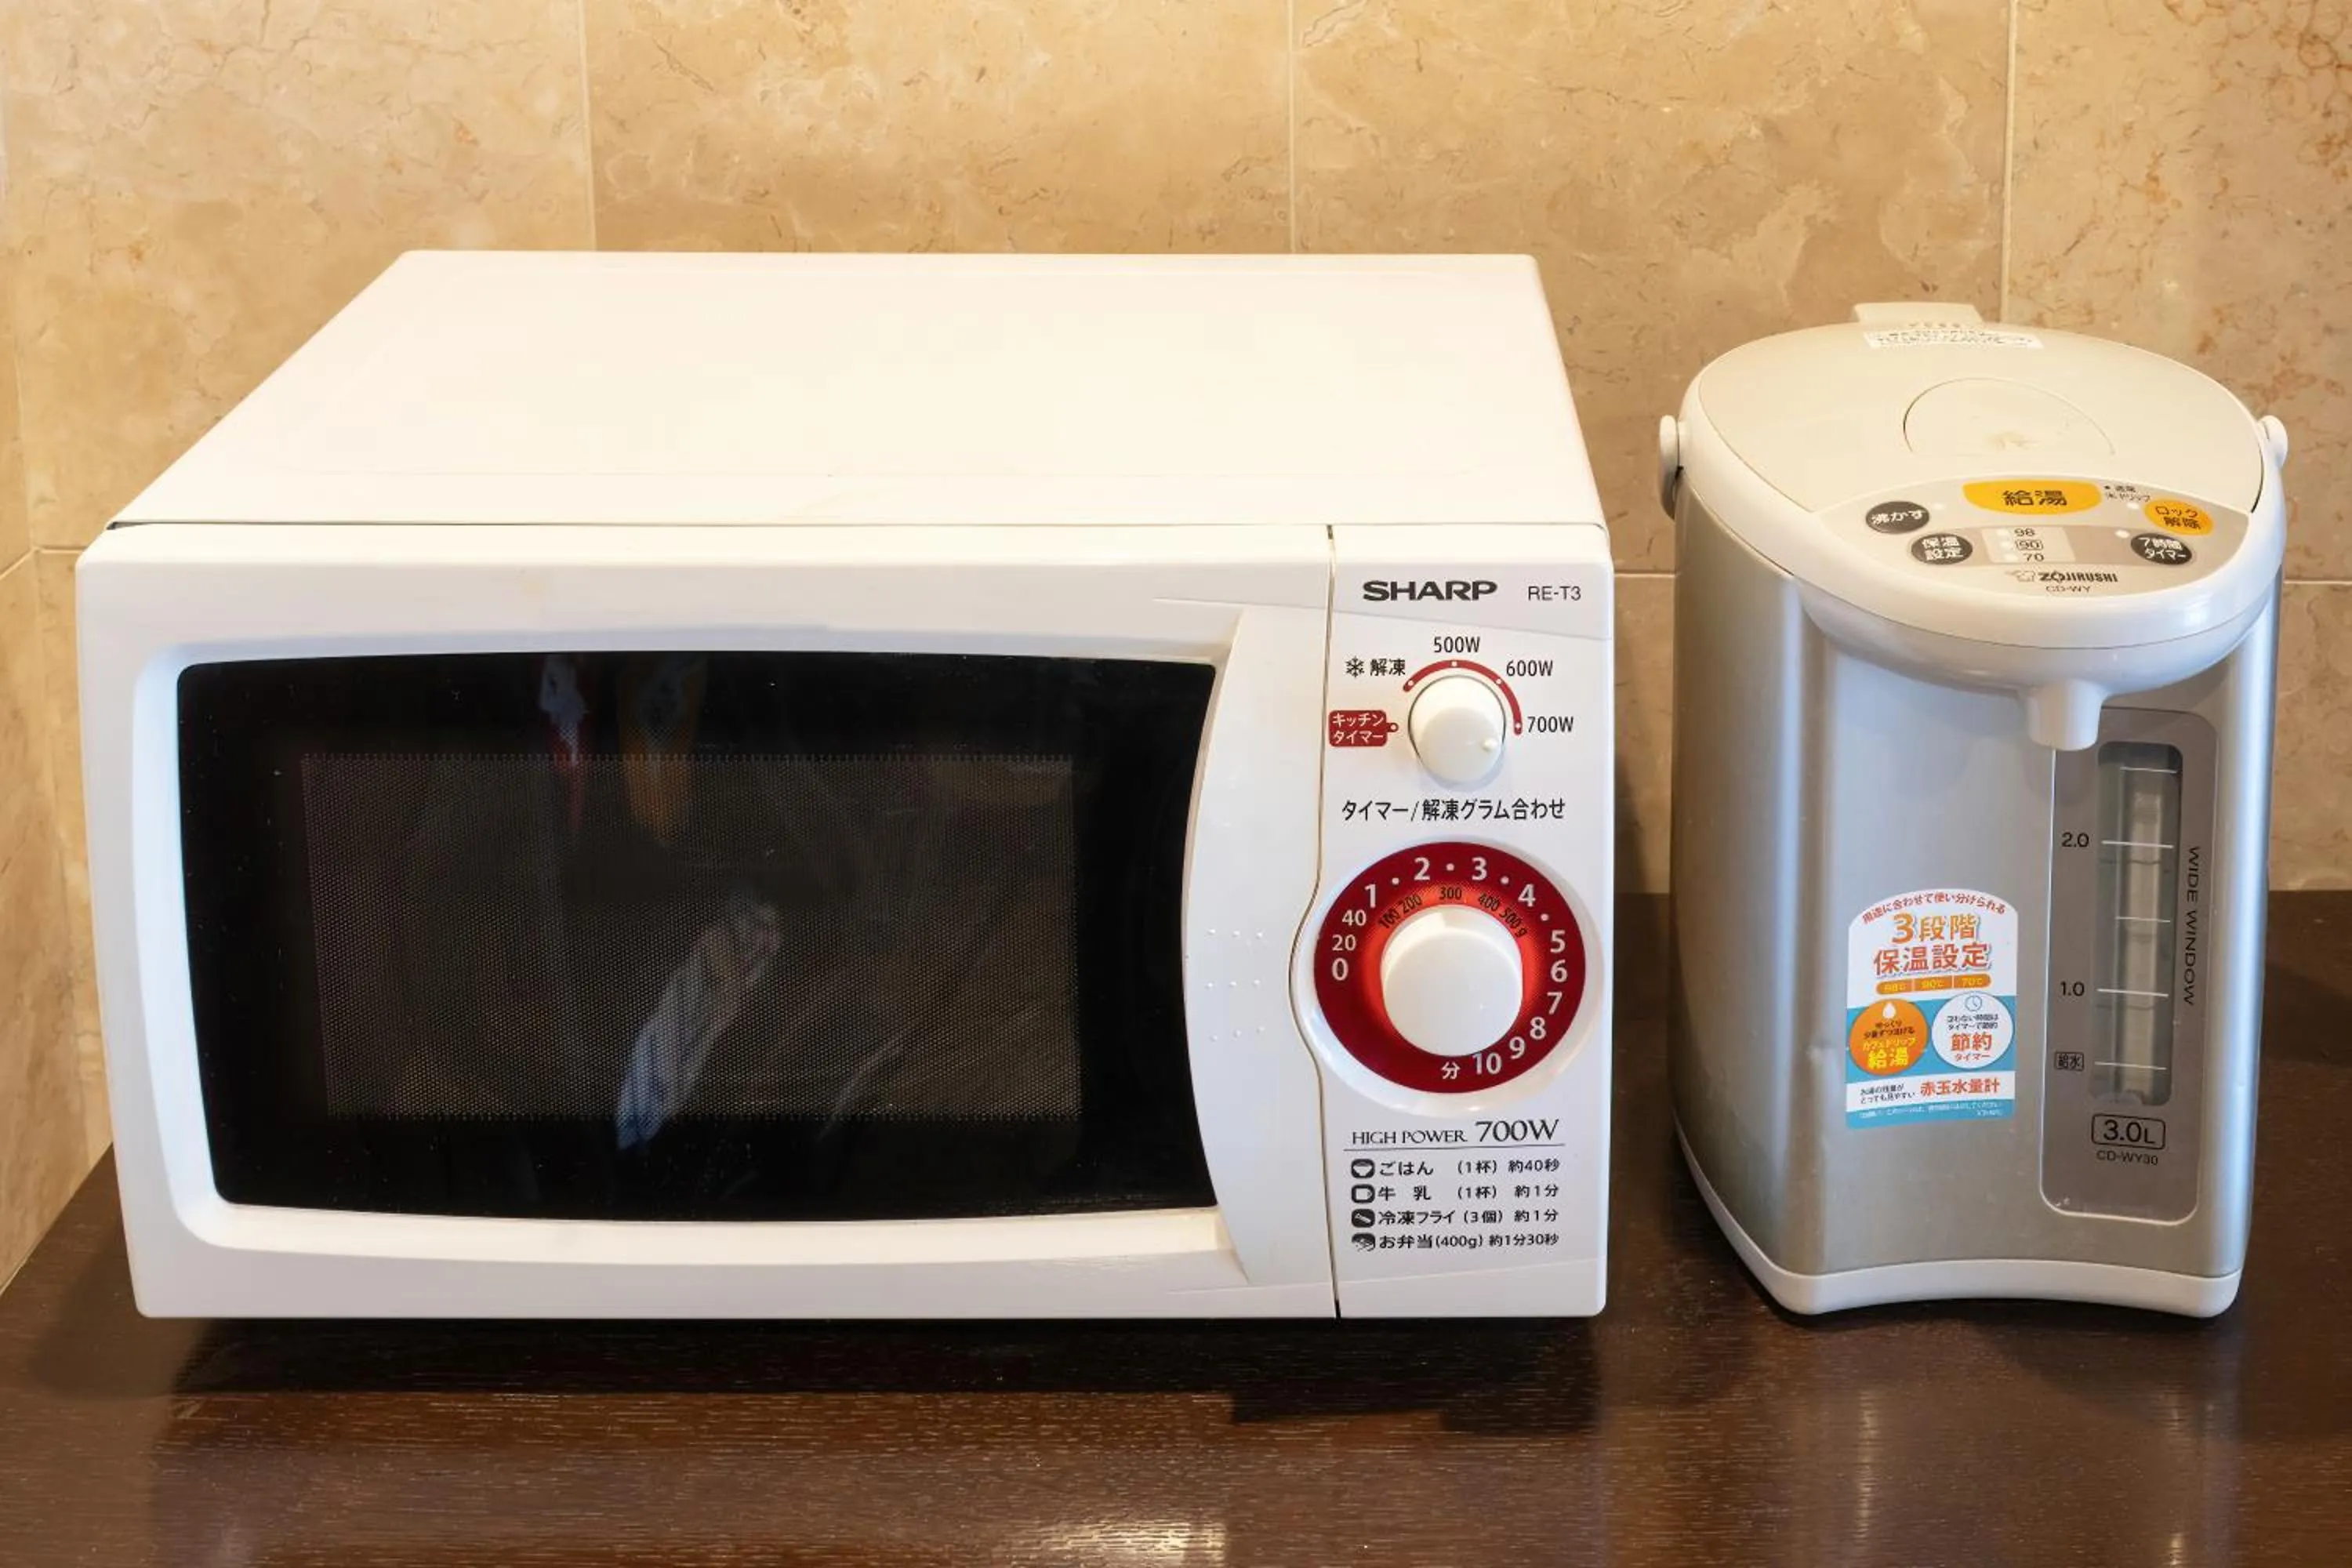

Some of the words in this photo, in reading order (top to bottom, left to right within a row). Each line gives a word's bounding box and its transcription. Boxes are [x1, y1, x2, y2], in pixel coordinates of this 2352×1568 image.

[2002, 488, 2068, 507] 給湯
[2154, 505, 2199, 519] ロック
[2163, 515, 2202, 531] 解除
[2013, 528, 2036, 538] 98
[1922, 535, 1962, 550] 保温
[1925, 547, 1964, 561] 設定
[2025, 553, 2045, 563] 70
[2143, 549, 2187, 560] タイマー
[2038, 571, 2119, 583] ZOJIRUSHI
[1363, 580, 1498, 601] SHARP
[1528, 585, 1582, 601] RE-T3
[2045, 585, 2092, 594] CD-WY
[1433, 636, 1481, 653] 500W
[1369, 658, 1406, 677] 解凍
[1505, 659, 1554, 677] 600W
[1332, 713, 1385, 728] キッチン
[1526, 716, 1574, 733] 700W
[1332, 729, 1385, 745] タイマー
[1341, 797, 1566, 822] タイマー/解凍グラム合わせ
[2061, 832, 2090, 848] 2.0
[1414, 857, 1431, 880] 2
[1472, 857, 1488, 880] 3
[2187, 846, 2201, 903] WIDE
[1364, 884, 1377, 908] 1
[1439, 887, 1462, 900] 300
[1518, 884, 1536, 907] 4
[1862, 891, 2006, 925] 用途に合わせて使い分けられる
[1341, 909, 1367, 926] 40
[1892, 912, 1979, 944] 3段階
[1333, 935, 1356, 951] 20
[1550, 930, 1566, 953] 5
[1873, 942, 1990, 976] 保温設定
[2183, 910, 2197, 1006] WINDOW
[1332, 957, 1349, 981] 0
[1550, 959, 1568, 982] 6
[2060, 981, 2085, 996] 1.0
[1547, 992, 1563, 1015] 7
[1530, 1016, 1547, 1040] 8
[1508, 1036, 1526, 1059] 9
[1950, 1031, 1993, 1052] 節約
[1472, 1052, 1502, 1075] 10
[1868, 1047, 1908, 1070] 給湯
[1955, 1053, 1991, 1062] タイマー
[2056, 1054, 2084, 1069] 給水
[1441, 1062, 1461, 1080] 分
[1920, 1077, 2001, 1097] 赤玉水量計
[1352, 1131, 1397, 1145] HIGH
[1402, 1129, 1468, 1143] POWER
[1475, 1119, 1560, 1143] 700W
[2103, 1120, 2155, 1145] 3.0L
[2096, 1149, 2159, 1166] CD-WY30
[1380, 1161, 1434, 1176] ごはん
[1457, 1160, 1497, 1175] (1杯)
[1508, 1158, 1560, 1173] 約40秒
[1457, 1185, 1497, 1200] (1杯)
[1514, 1184, 1559, 1199] 約1分
[1377, 1210, 1456, 1225] 冷凍フライ
[1464, 1210, 1503, 1224] (3個)
[1514, 1209, 1559, 1223] 約1分
[1489, 1233, 1559, 1247] 約1分30秒
